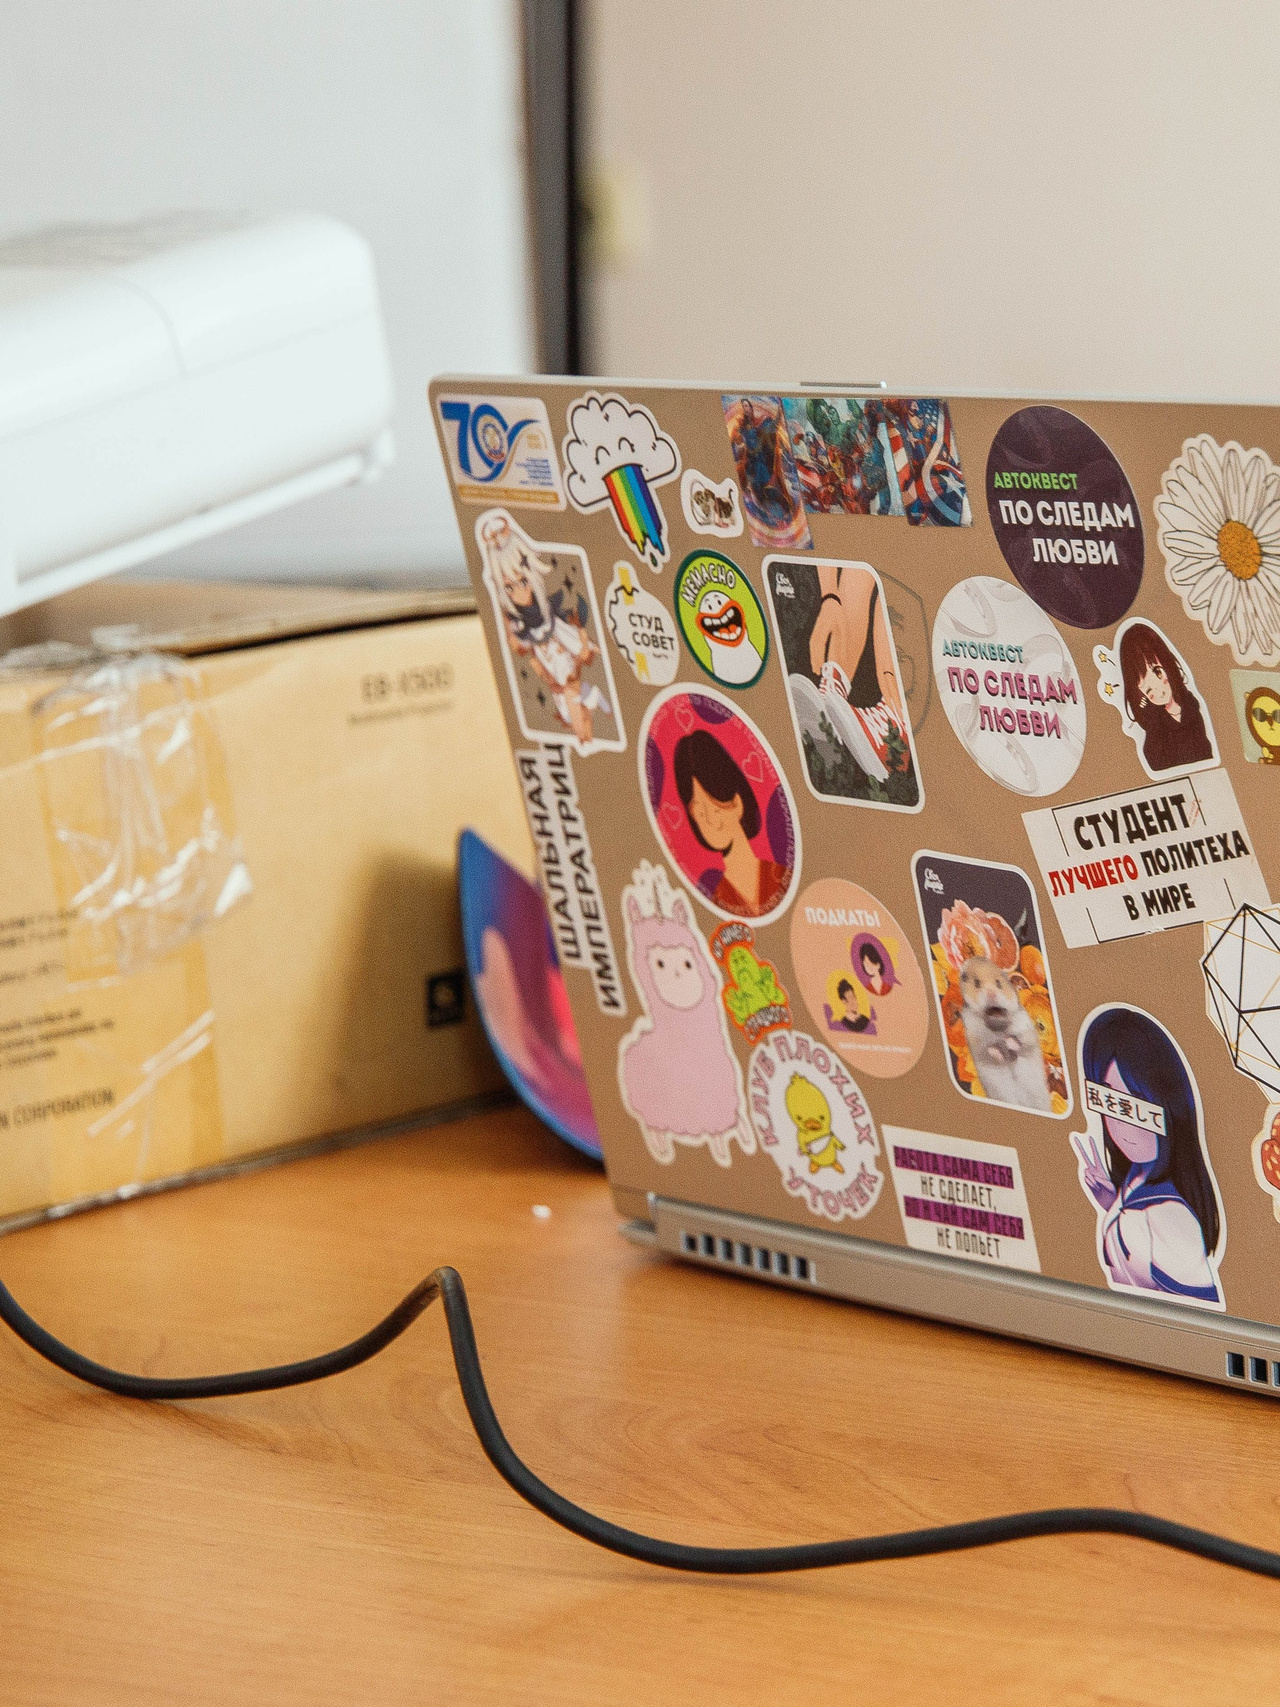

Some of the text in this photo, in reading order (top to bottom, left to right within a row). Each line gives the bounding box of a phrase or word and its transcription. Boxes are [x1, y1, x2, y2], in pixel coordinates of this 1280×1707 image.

[994, 471, 1077, 491] АВТОКВЕСТ
[999, 499, 1136, 533] ПО СЛЕДАМ
[1032, 537, 1119, 566] ЛЮБВИ
[628, 612, 664, 633] СТУД
[632, 632, 675, 651] СОВЕТ
[942, 639, 1024, 664] АВТОКВЕСТ
[947, 666, 1078, 705] ПО СЛЕДАМ
[978, 703, 1062, 739] ЛЮБВИ
[1073, 793, 1194, 851] СТУДЕНТ
[519, 756, 582, 960] ШАЛЬНАЯ
[544, 743, 621, 1009] ИМПЕРАТРИЦ
[1048, 829, 1251, 897] ЛУЧШЕГО ПОЛИТЕХА
[804, 906, 881, 927] ПОДКАТЫ
[1123, 882, 1196, 921] В МИРЕ
[751, 1035, 875, 1147] КЛУБ ПЛОХИХ
[1088, 1086, 1162, 1129] 私を愛して
[787, 1162, 878, 1216] УТОЧЕК
[920, 1176, 997, 1210] НЕ СДЕЛАЕТ,
[937, 1227, 951, 1249] НЕ
